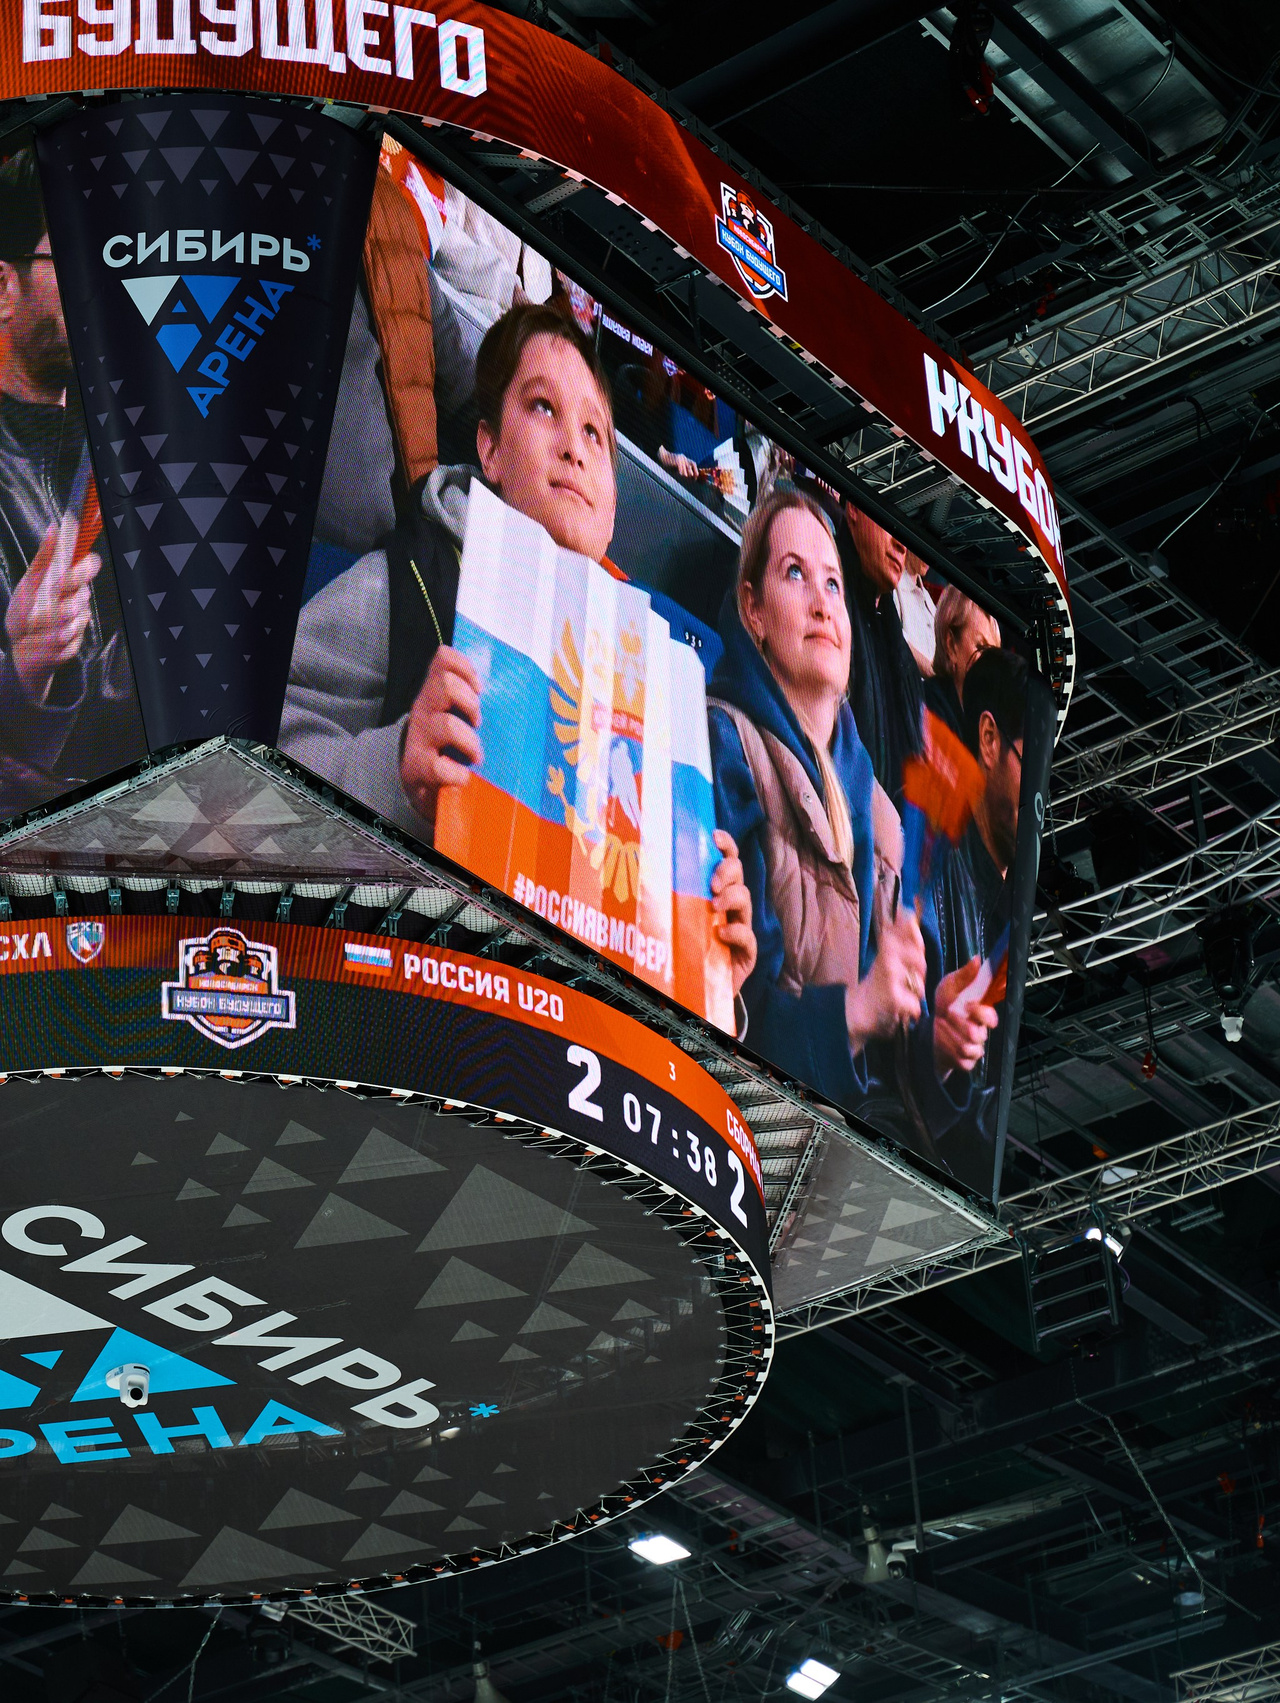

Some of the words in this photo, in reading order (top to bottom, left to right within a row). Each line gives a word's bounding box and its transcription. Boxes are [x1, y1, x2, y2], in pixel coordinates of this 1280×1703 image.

[23, 0, 487, 97] БУДУЩЕГО
[102, 229, 311, 273] СИБИРЬ
[186, 279, 296, 419] АРЕНА
[403, 952, 510, 1005] РОССИЯ
[517, 982, 564, 1023] U20
[567, 1045, 604, 1122] 2
[669, 1061, 677, 1081] 3
[622, 1092, 718, 1188] 07:38
[727, 1149, 748, 1229] 2
[1, 1205, 440, 1429] СИБИРЬ
